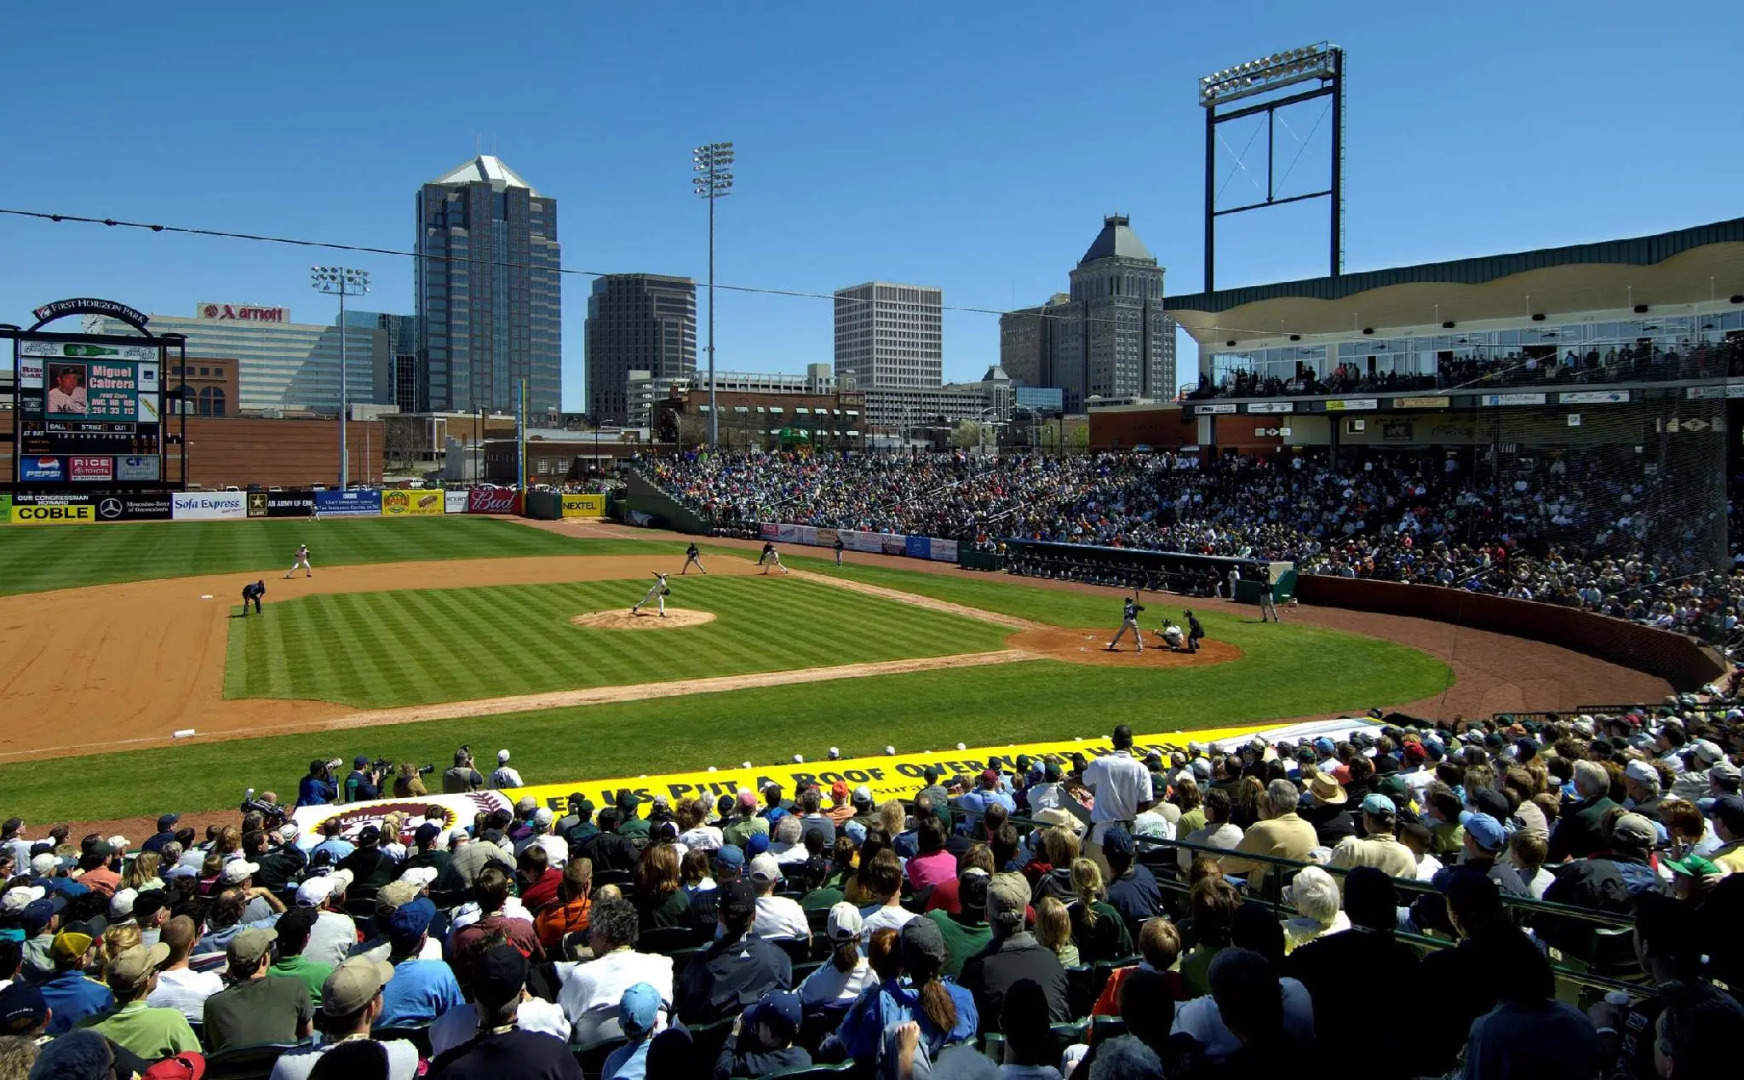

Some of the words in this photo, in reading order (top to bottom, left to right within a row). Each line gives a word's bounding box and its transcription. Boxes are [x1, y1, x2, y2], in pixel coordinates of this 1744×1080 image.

[51, 301, 77, 312] FIRST
[78, 299, 121, 312] HORIZON
[123, 308, 144, 323] PARK
[92, 366, 132, 378] Miguel
[89, 377, 135, 389] Cabrera
[74, 459, 109, 467] RICE
[175, 498, 198, 510] Sofa
[201, 499, 239, 510] Express
[472, 491, 515, 510] Bud
[563, 501, 596, 510] NEXTEL
[19, 507, 89, 519] COBLE
[667, 781, 739, 800] PUT
[790, 768, 886, 788] ROOF
[895, 760, 987, 778] OVER
